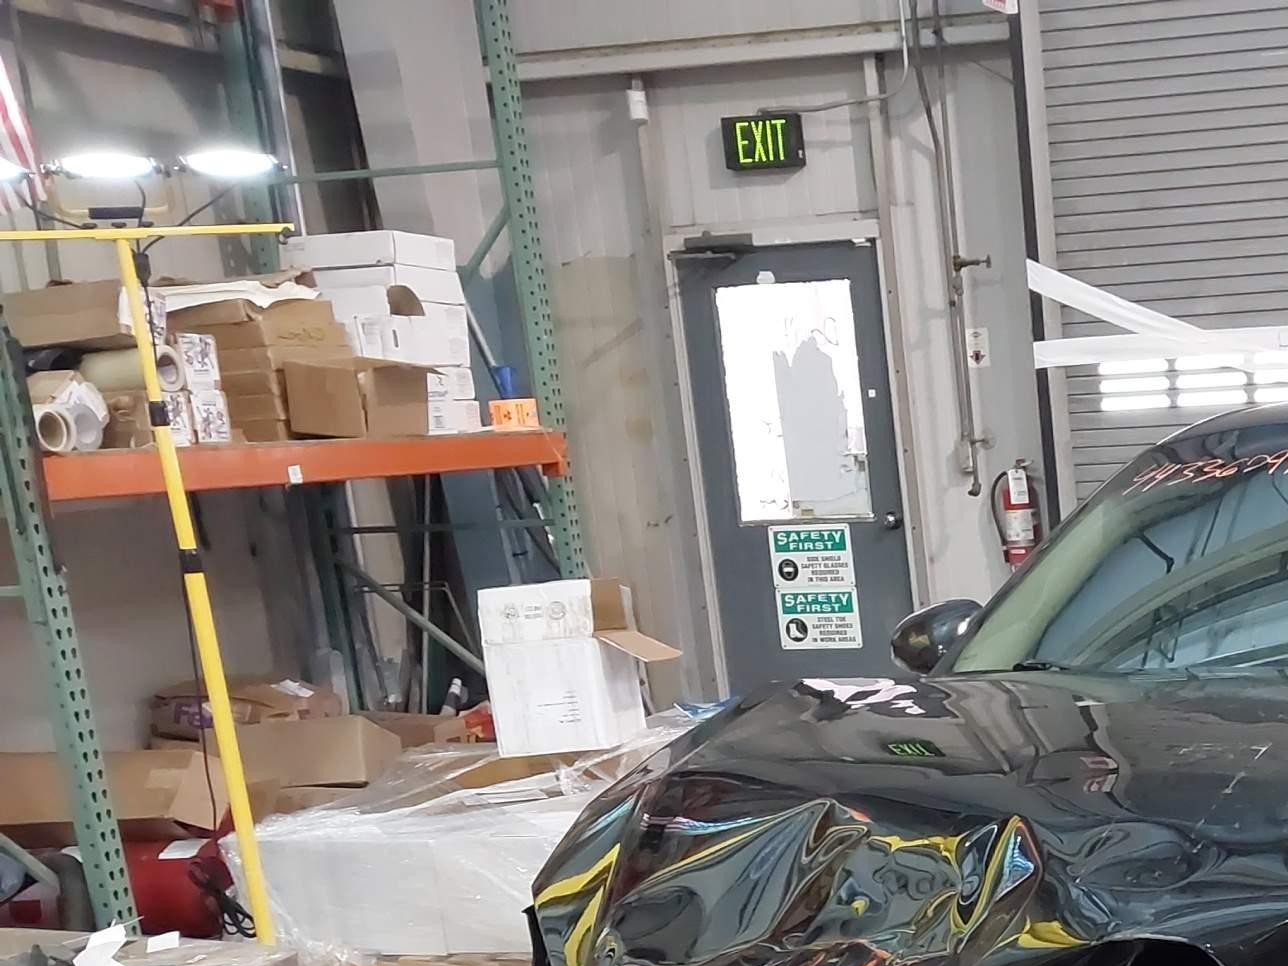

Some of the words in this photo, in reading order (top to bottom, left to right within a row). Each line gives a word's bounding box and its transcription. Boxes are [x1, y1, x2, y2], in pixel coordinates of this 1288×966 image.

[736, 119, 786, 163] EXIT
[776, 530, 842, 545] SAFETY
[789, 541, 834, 551] FIRST
[784, 593, 849, 607] SAFETY
[796, 604, 841, 612] FIRST
